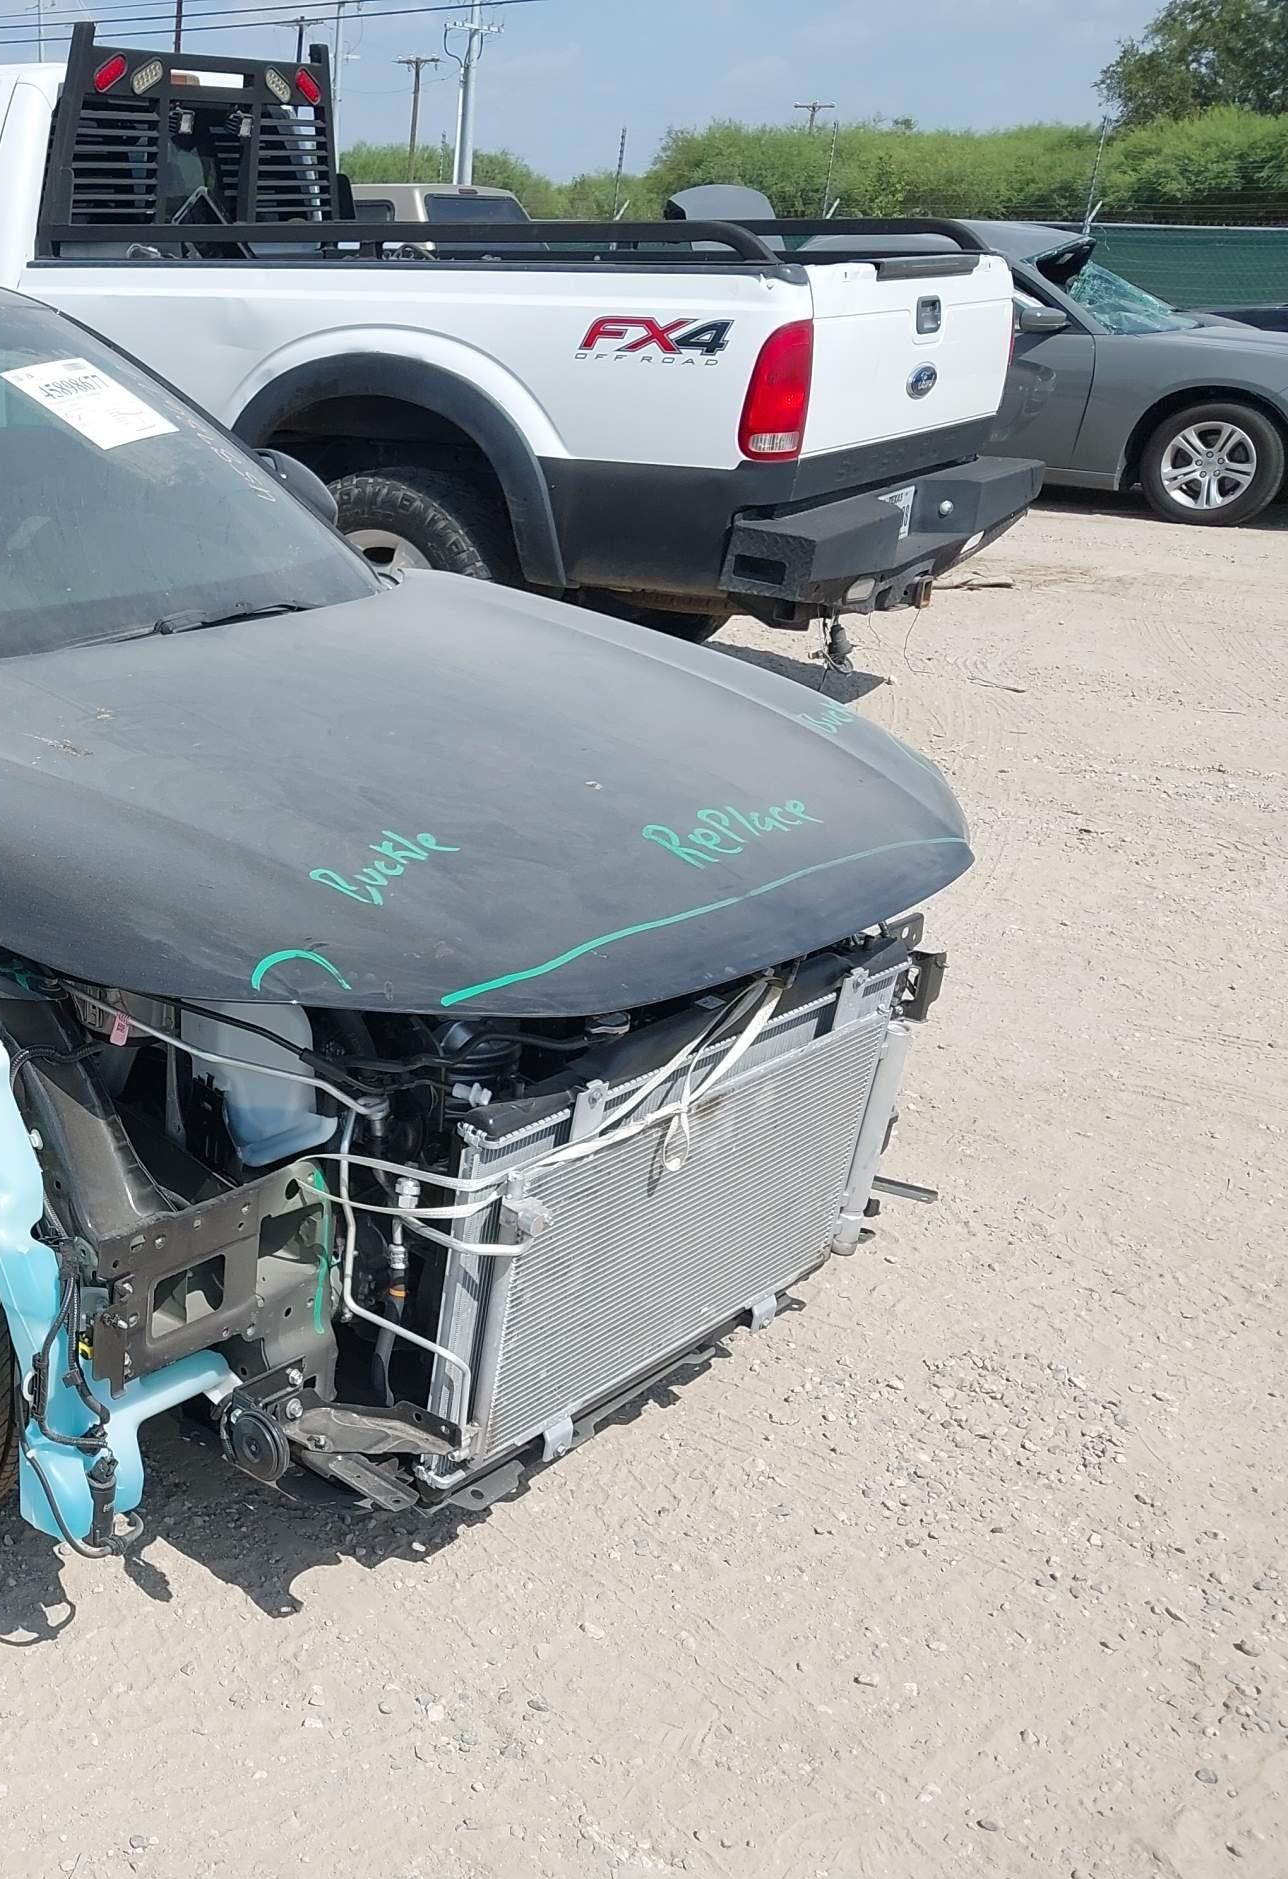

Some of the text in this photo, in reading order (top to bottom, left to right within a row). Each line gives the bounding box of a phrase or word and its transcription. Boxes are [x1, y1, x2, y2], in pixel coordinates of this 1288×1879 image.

[579, 315, 735, 356] FX4
[574, 352, 719, 366] OFF ROAD
